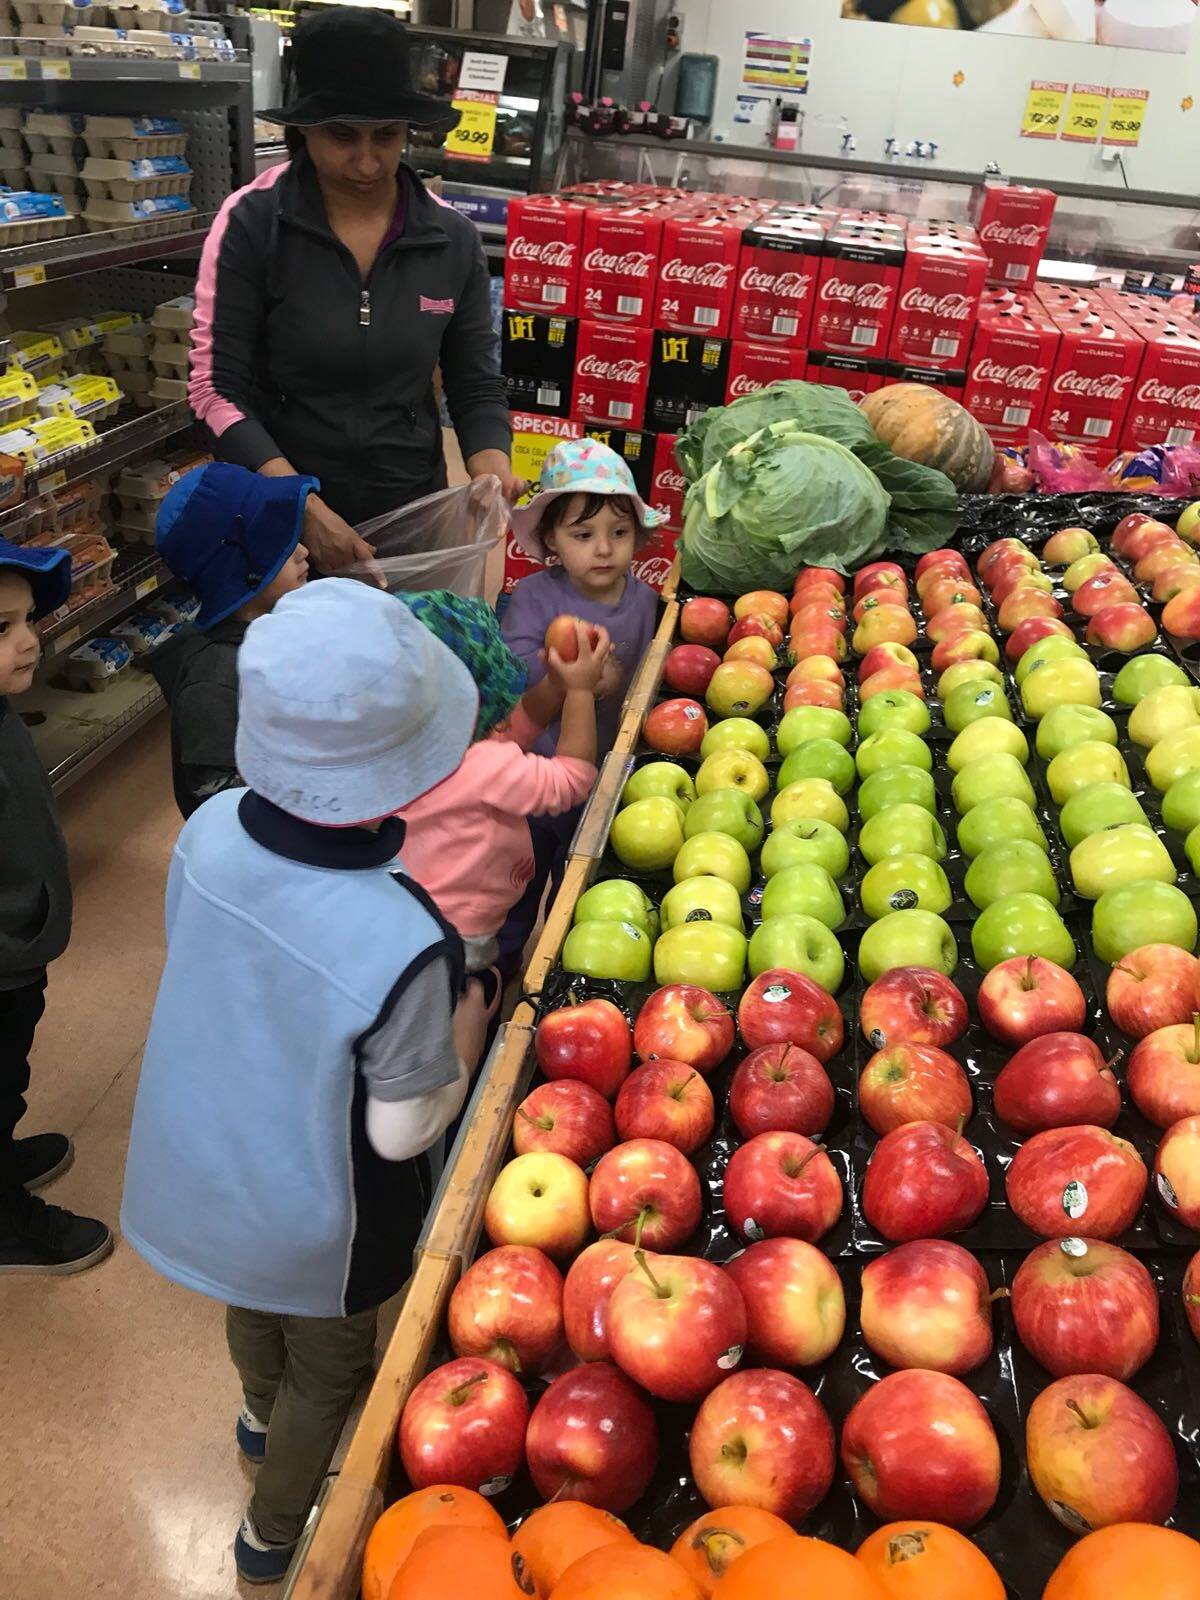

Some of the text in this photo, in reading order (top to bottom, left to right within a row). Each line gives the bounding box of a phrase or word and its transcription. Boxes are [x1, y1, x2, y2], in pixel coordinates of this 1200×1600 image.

[585, 288, 603, 301] 24
[661, 299, 679, 312] 24
[508, 315, 536, 341] LIFT
[661, 337, 689, 363] LIFT
[577, 392, 594, 405] 24
[1050, 409, 1070, 423] 24
[512, 415, 580, 439] SPECIAL
[514, 444, 530, 454] COCA
